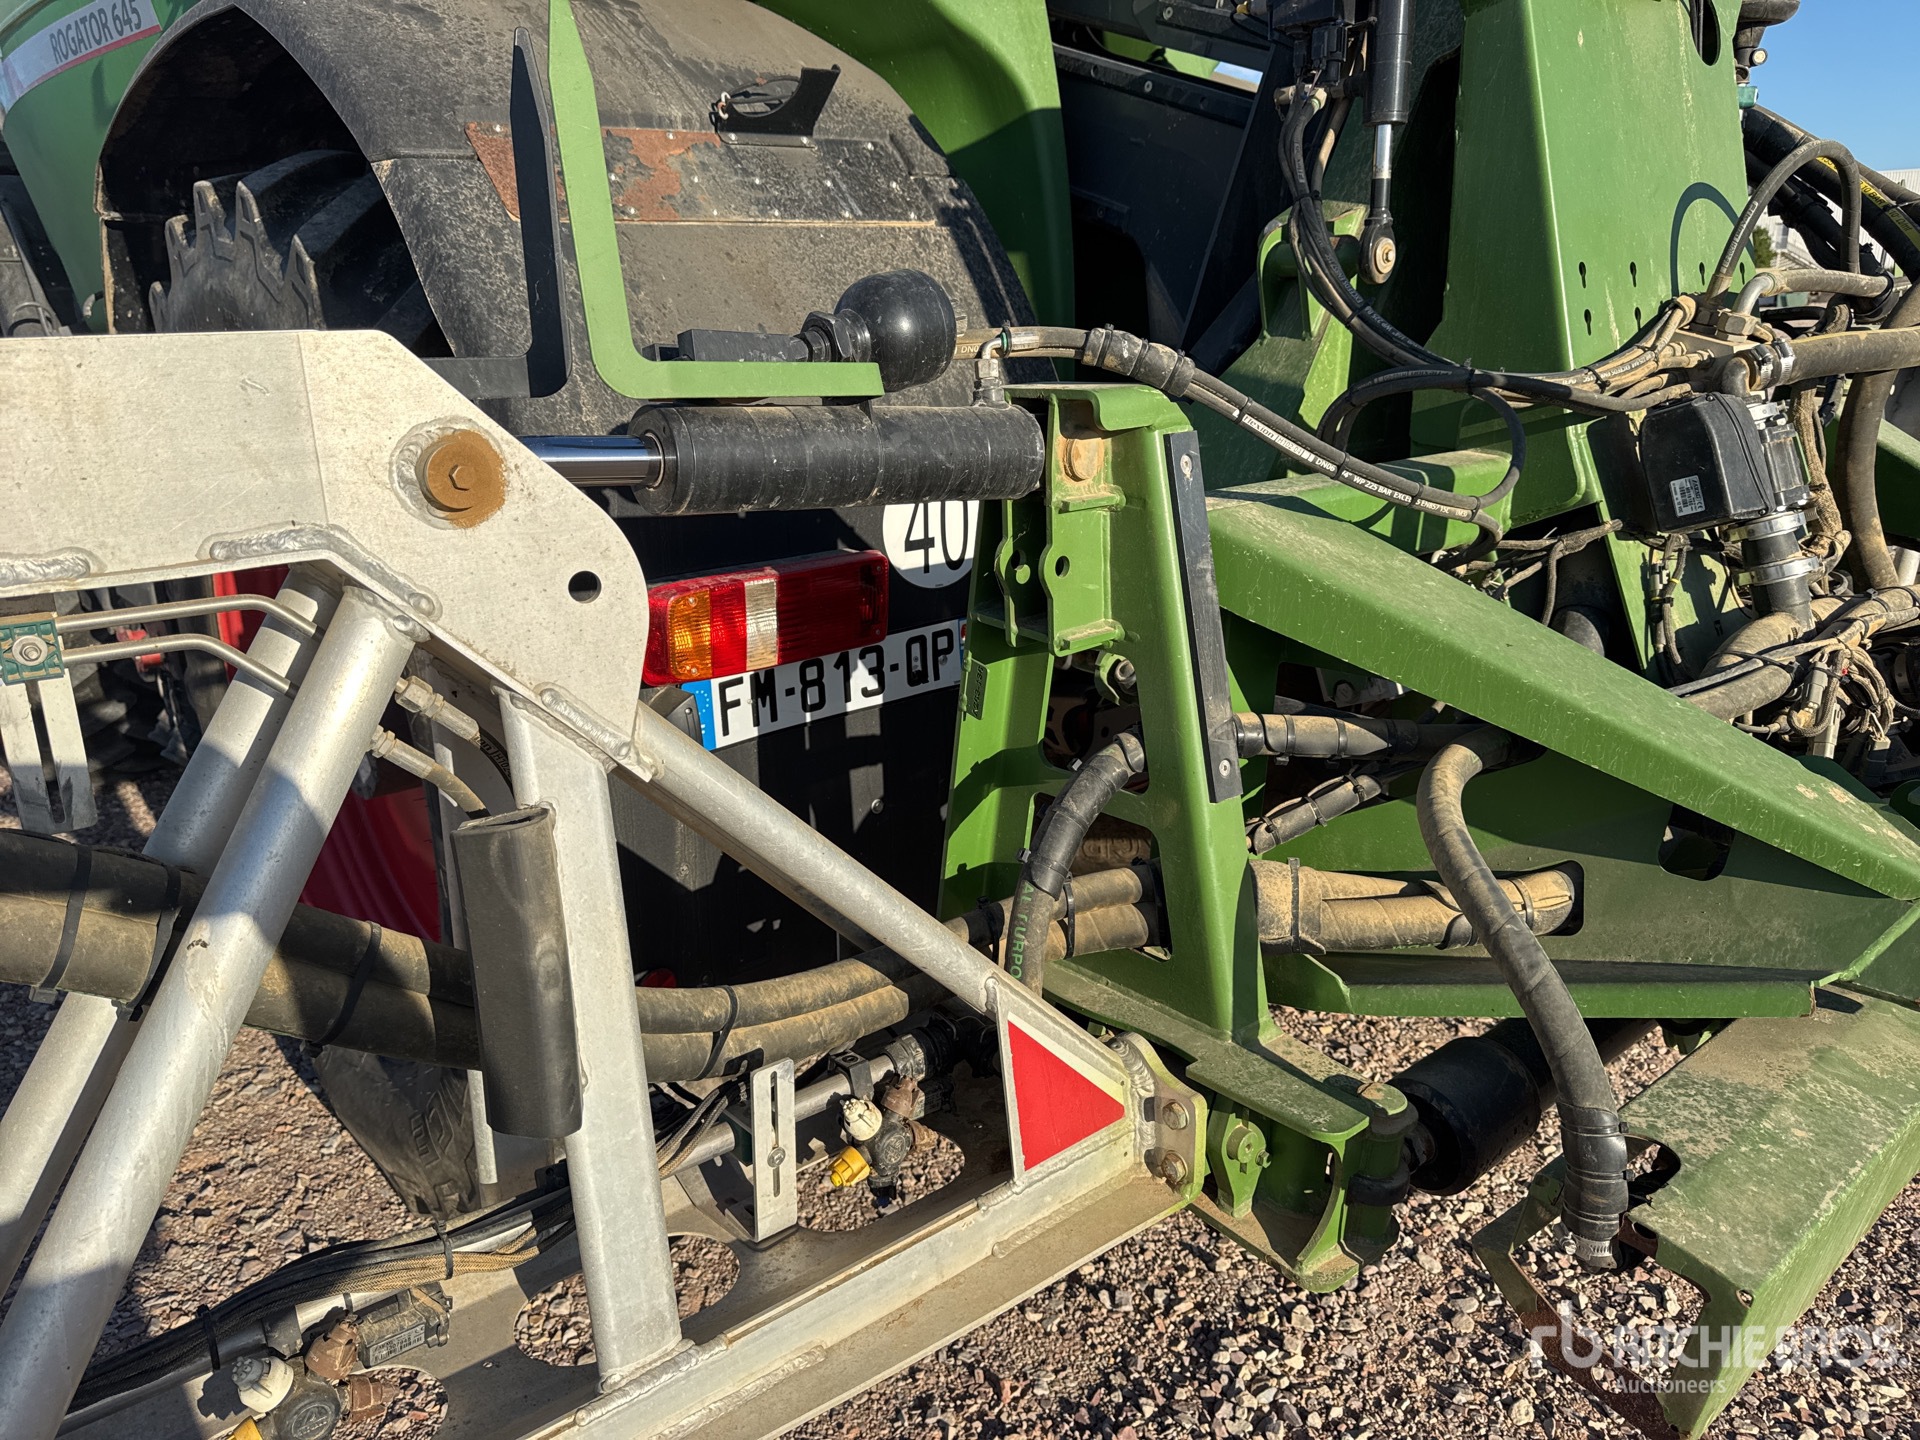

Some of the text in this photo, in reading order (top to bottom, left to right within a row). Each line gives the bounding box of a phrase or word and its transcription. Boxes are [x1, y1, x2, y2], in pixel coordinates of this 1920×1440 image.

[50, 0, 141, 64] ROGATOR 645
[1315, 457, 1336, 472] DN06
[1365, 480, 1379, 492] 225
[1378, 486, 1392, 497] BAR
[904, 502, 969, 575] 40
[718, 628, 955, 737] FM-813-QP
